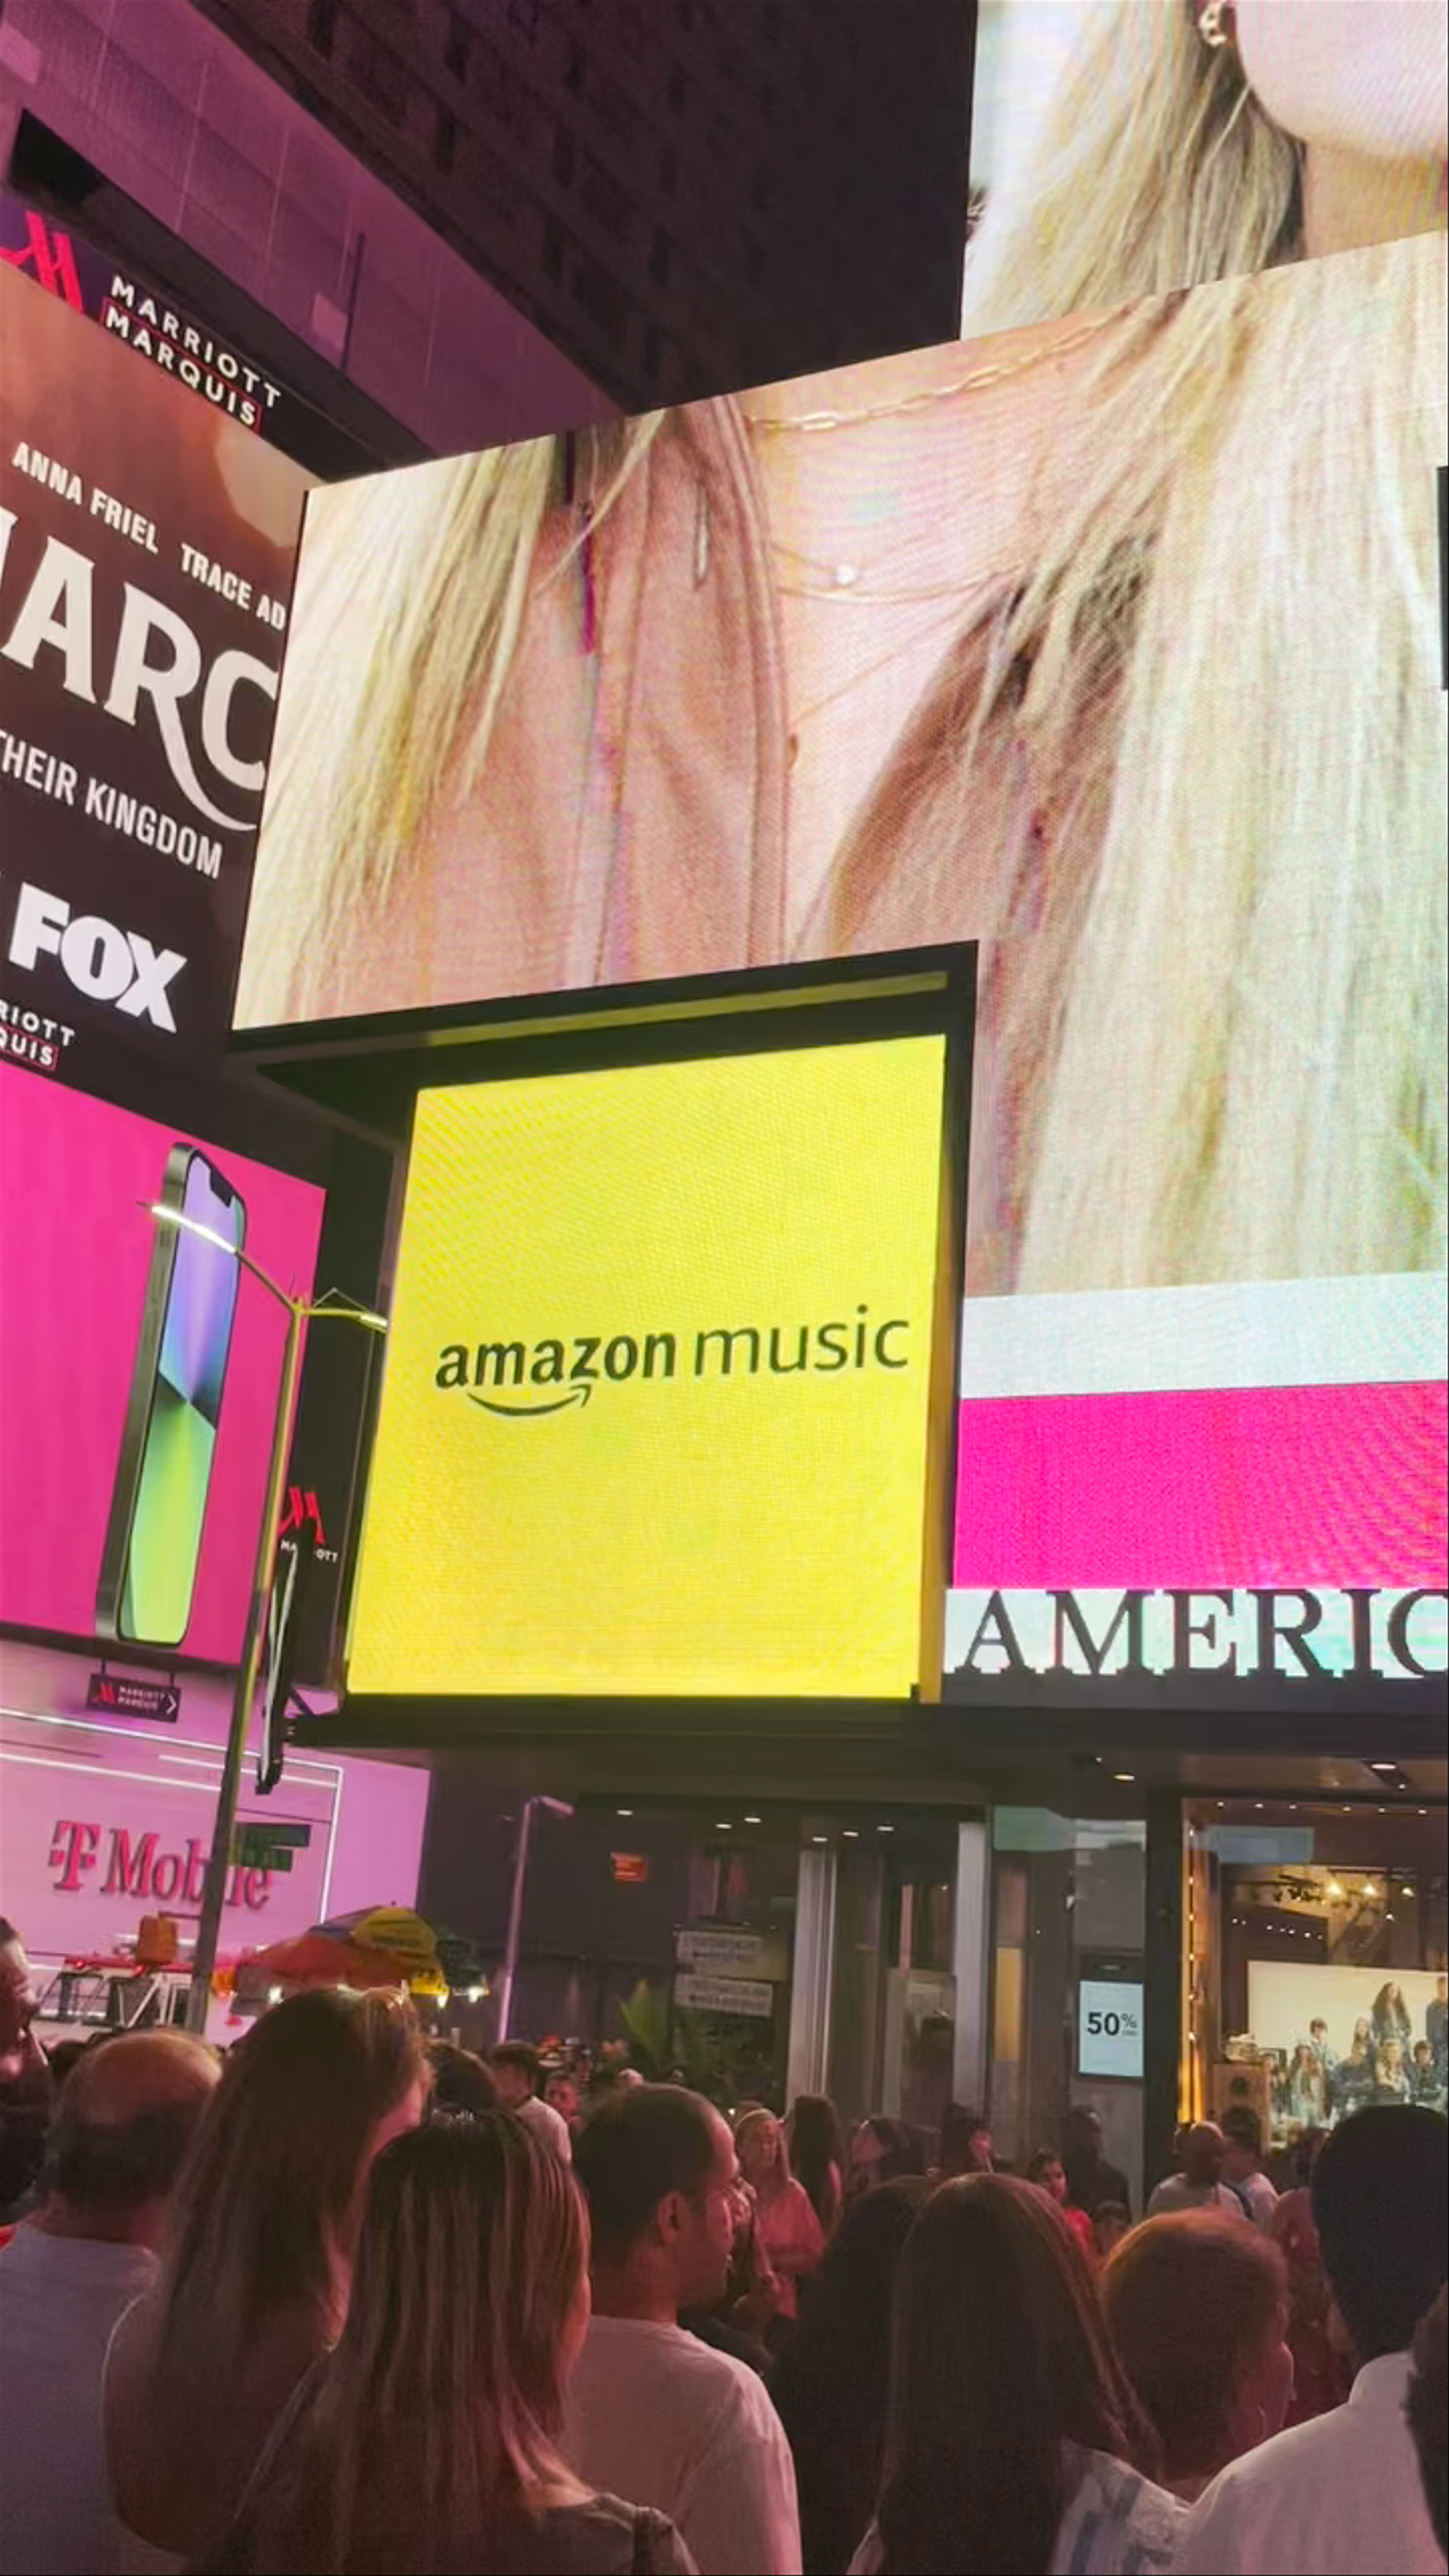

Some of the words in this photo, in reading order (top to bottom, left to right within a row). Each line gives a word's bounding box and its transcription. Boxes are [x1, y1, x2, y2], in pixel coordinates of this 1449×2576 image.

[106, 306, 256, 426] MARQUIS
[111, 276, 281, 408] MARRIOTT
[12, 442, 83, 505] ANNA
[89, 487, 159, 554] FRIEL
[180, 542, 252, 609] TRACE
[256, 594, 286, 631] AD
[0, 506, 280, 830] ARC
[85, 777, 223, 880] KINGDOM
[9, 881, 188, 1034] FOX
[435, 1332, 676, 1389] amazon
[694, 1304, 910, 1376] music
[954, 1589, 1448, 1676] AMERIC
